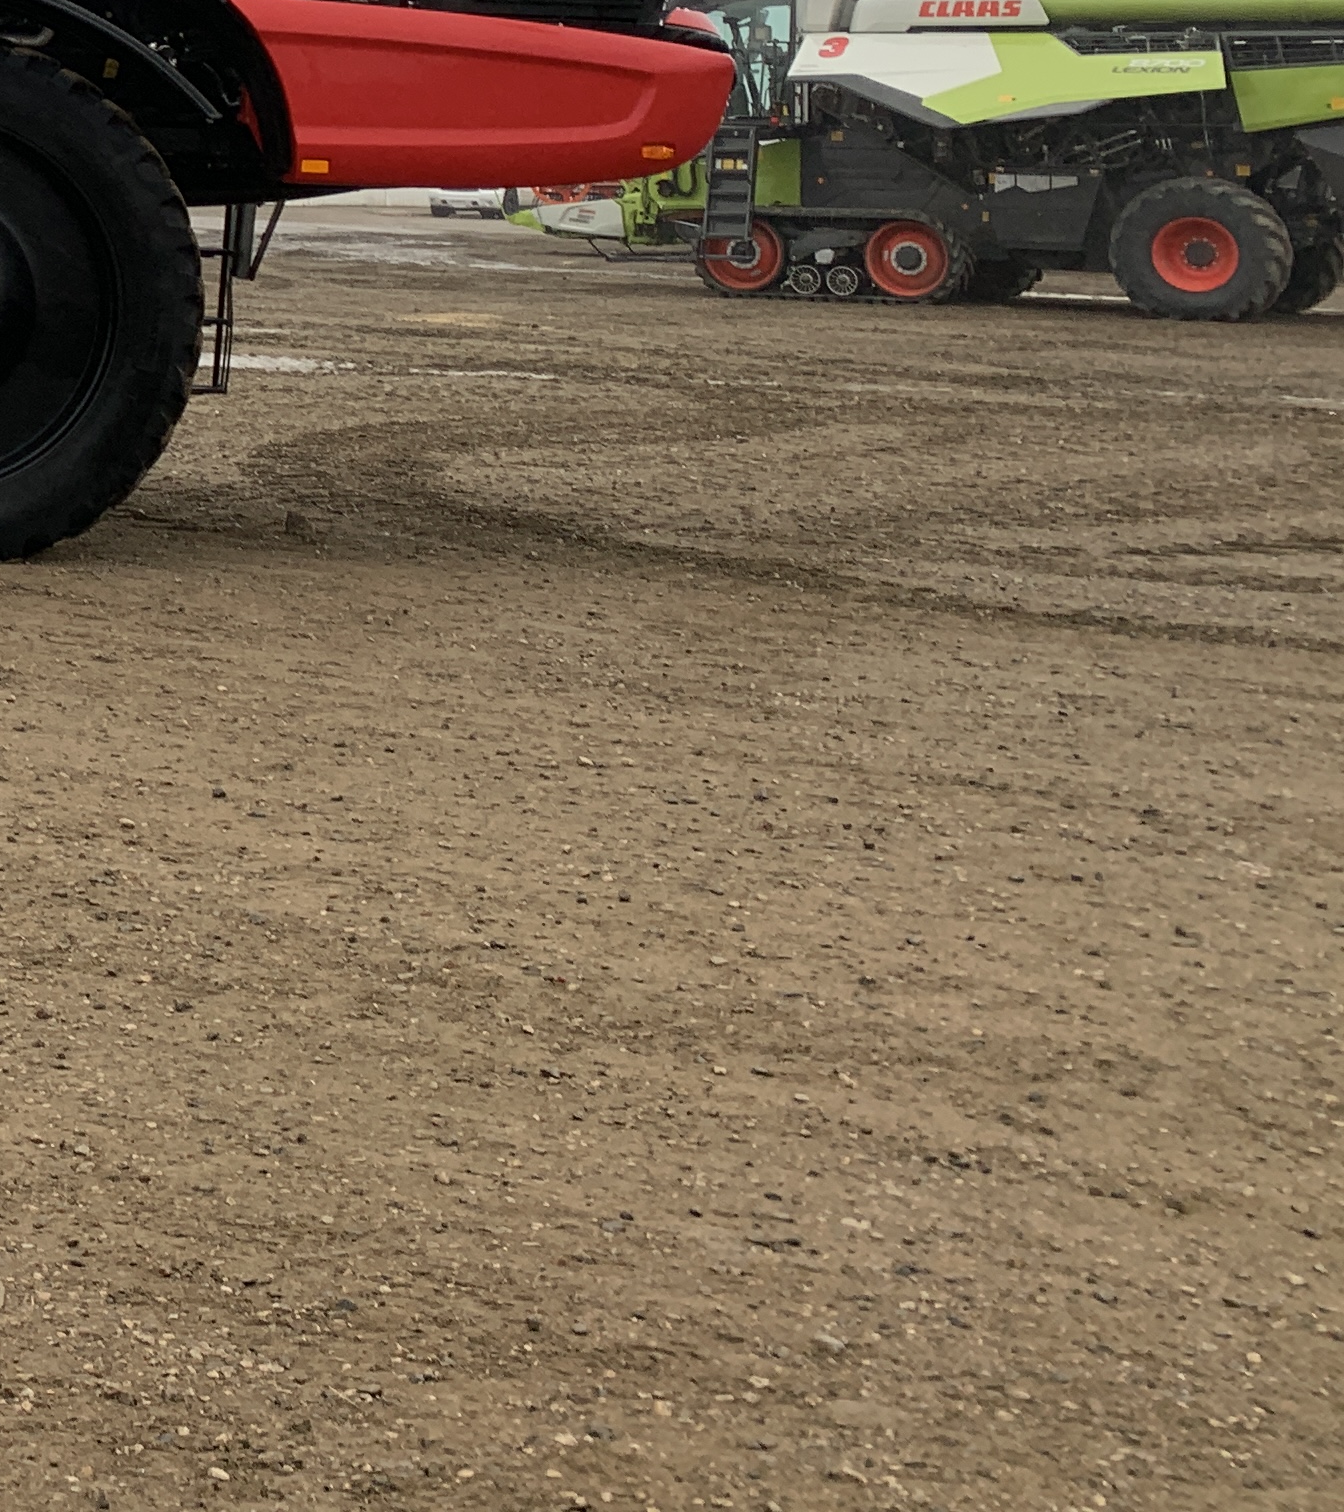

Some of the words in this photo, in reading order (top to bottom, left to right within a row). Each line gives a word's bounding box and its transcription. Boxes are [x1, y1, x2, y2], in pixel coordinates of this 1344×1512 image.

[918, 0, 1022, 18] CLAAS
[818, 37, 849, 58] 3
[1111, 66, 1191, 74] LEXION
